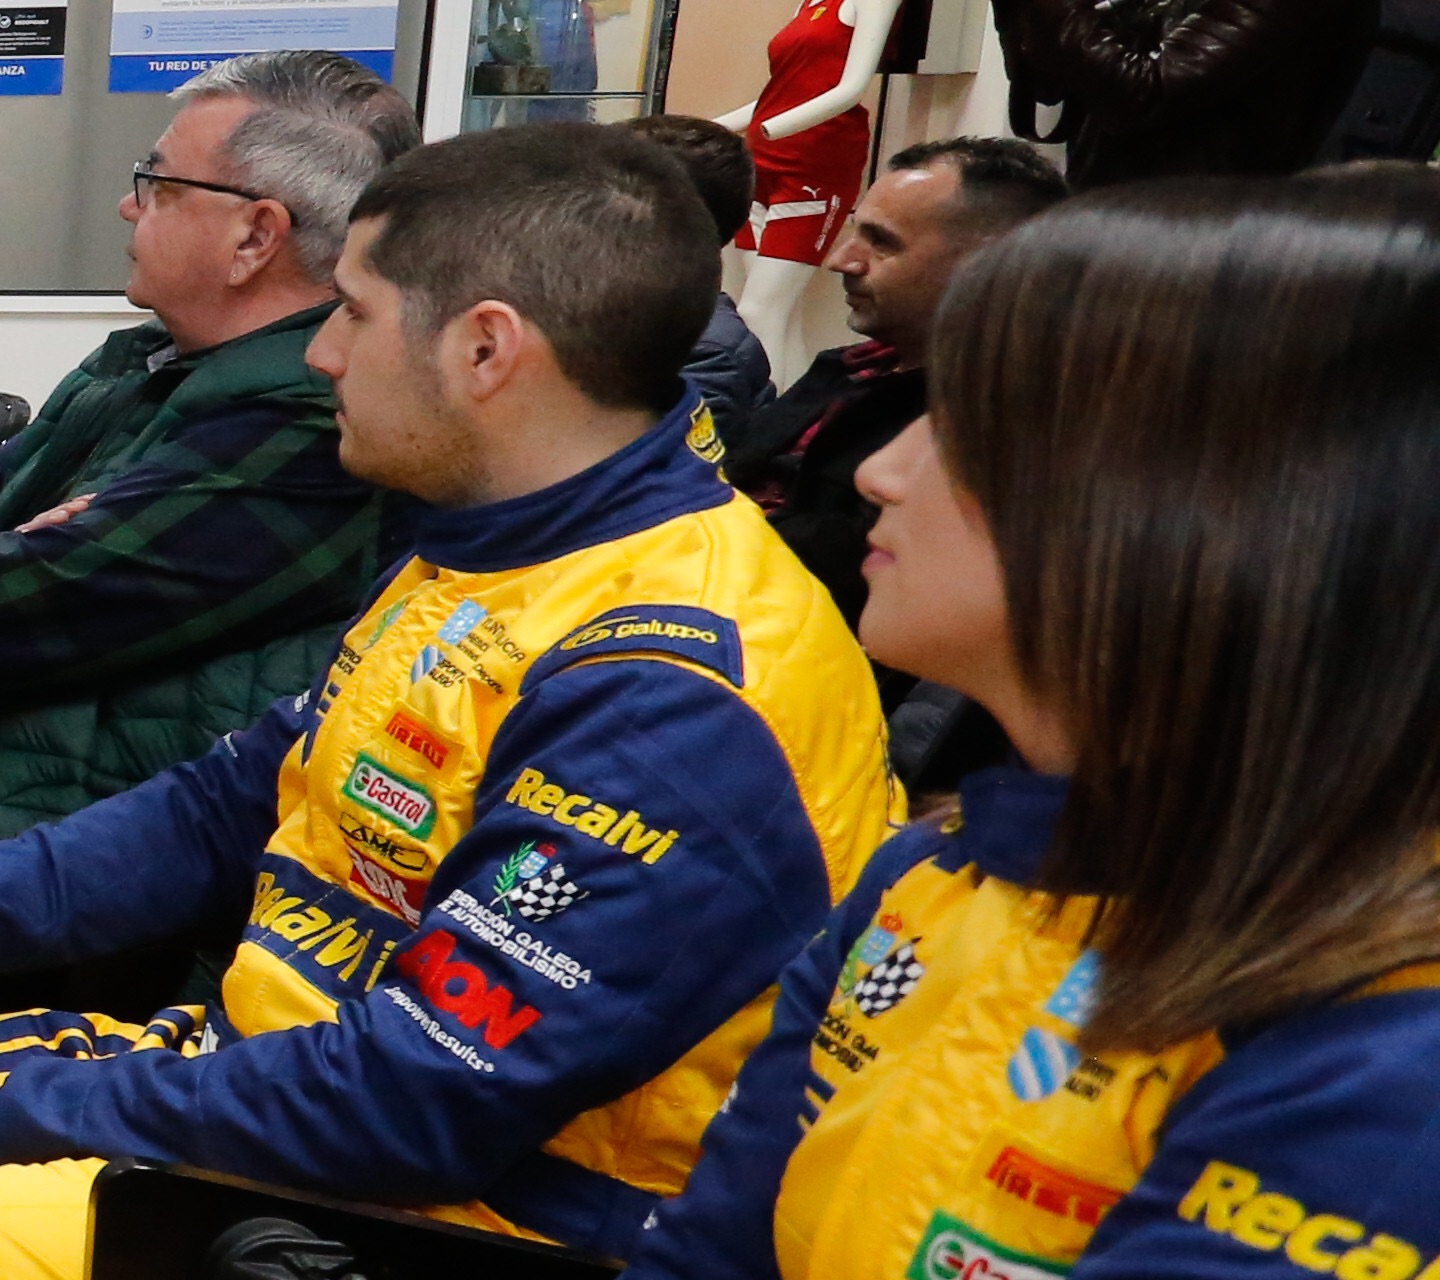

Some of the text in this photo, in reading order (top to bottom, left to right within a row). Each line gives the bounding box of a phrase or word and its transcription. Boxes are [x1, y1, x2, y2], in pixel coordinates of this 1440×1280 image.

[149, 61, 207, 71] TU RED DE
[615, 618, 719, 646] galuppo
[367, 777, 427, 823] Castrol
[505, 767, 680, 866] Recalvi
[447, 908, 578, 990] AUTOMOBILISMO
[515, 932, 593, 984] GALEGA
[395, 928, 543, 1051] AON
